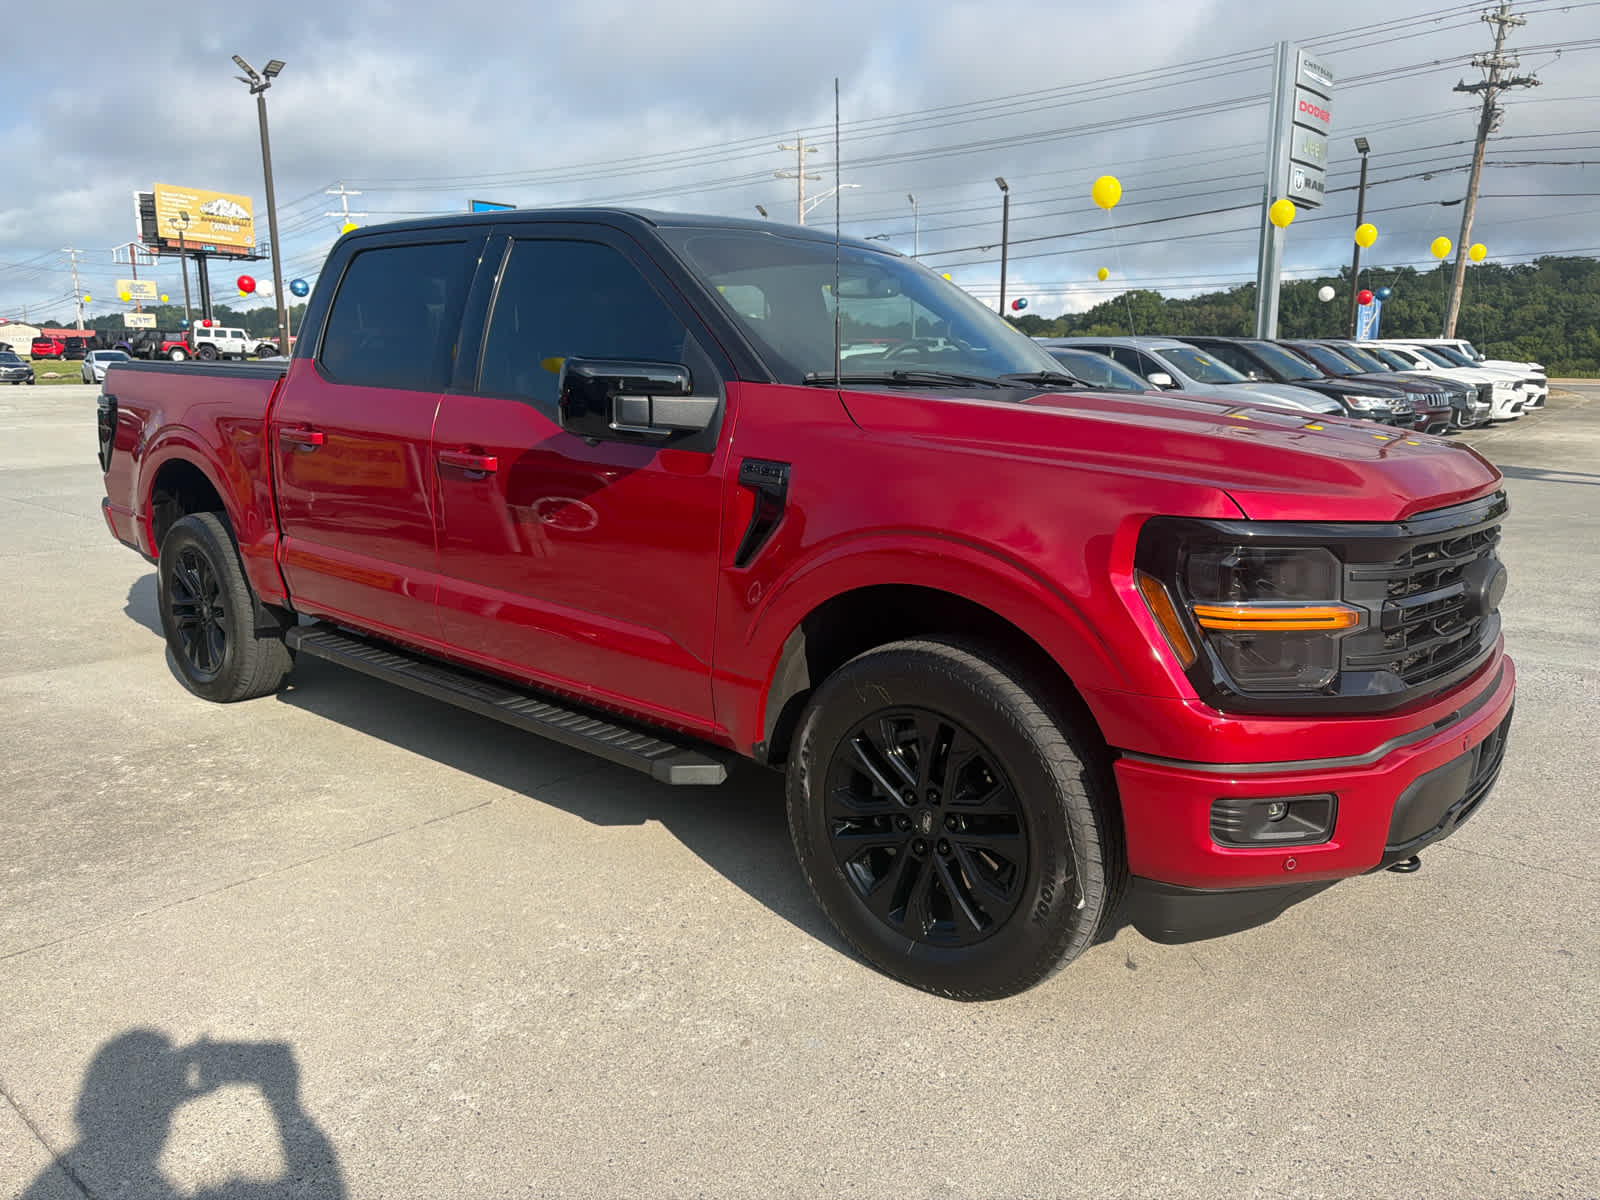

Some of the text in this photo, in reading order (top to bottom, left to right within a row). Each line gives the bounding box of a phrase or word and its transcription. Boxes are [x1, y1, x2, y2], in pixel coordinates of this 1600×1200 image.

[1303, 60, 1333, 79] CHRYSLER
[1300, 101, 1330, 123] DODGE
[1304, 177, 1325, 193] RAM
